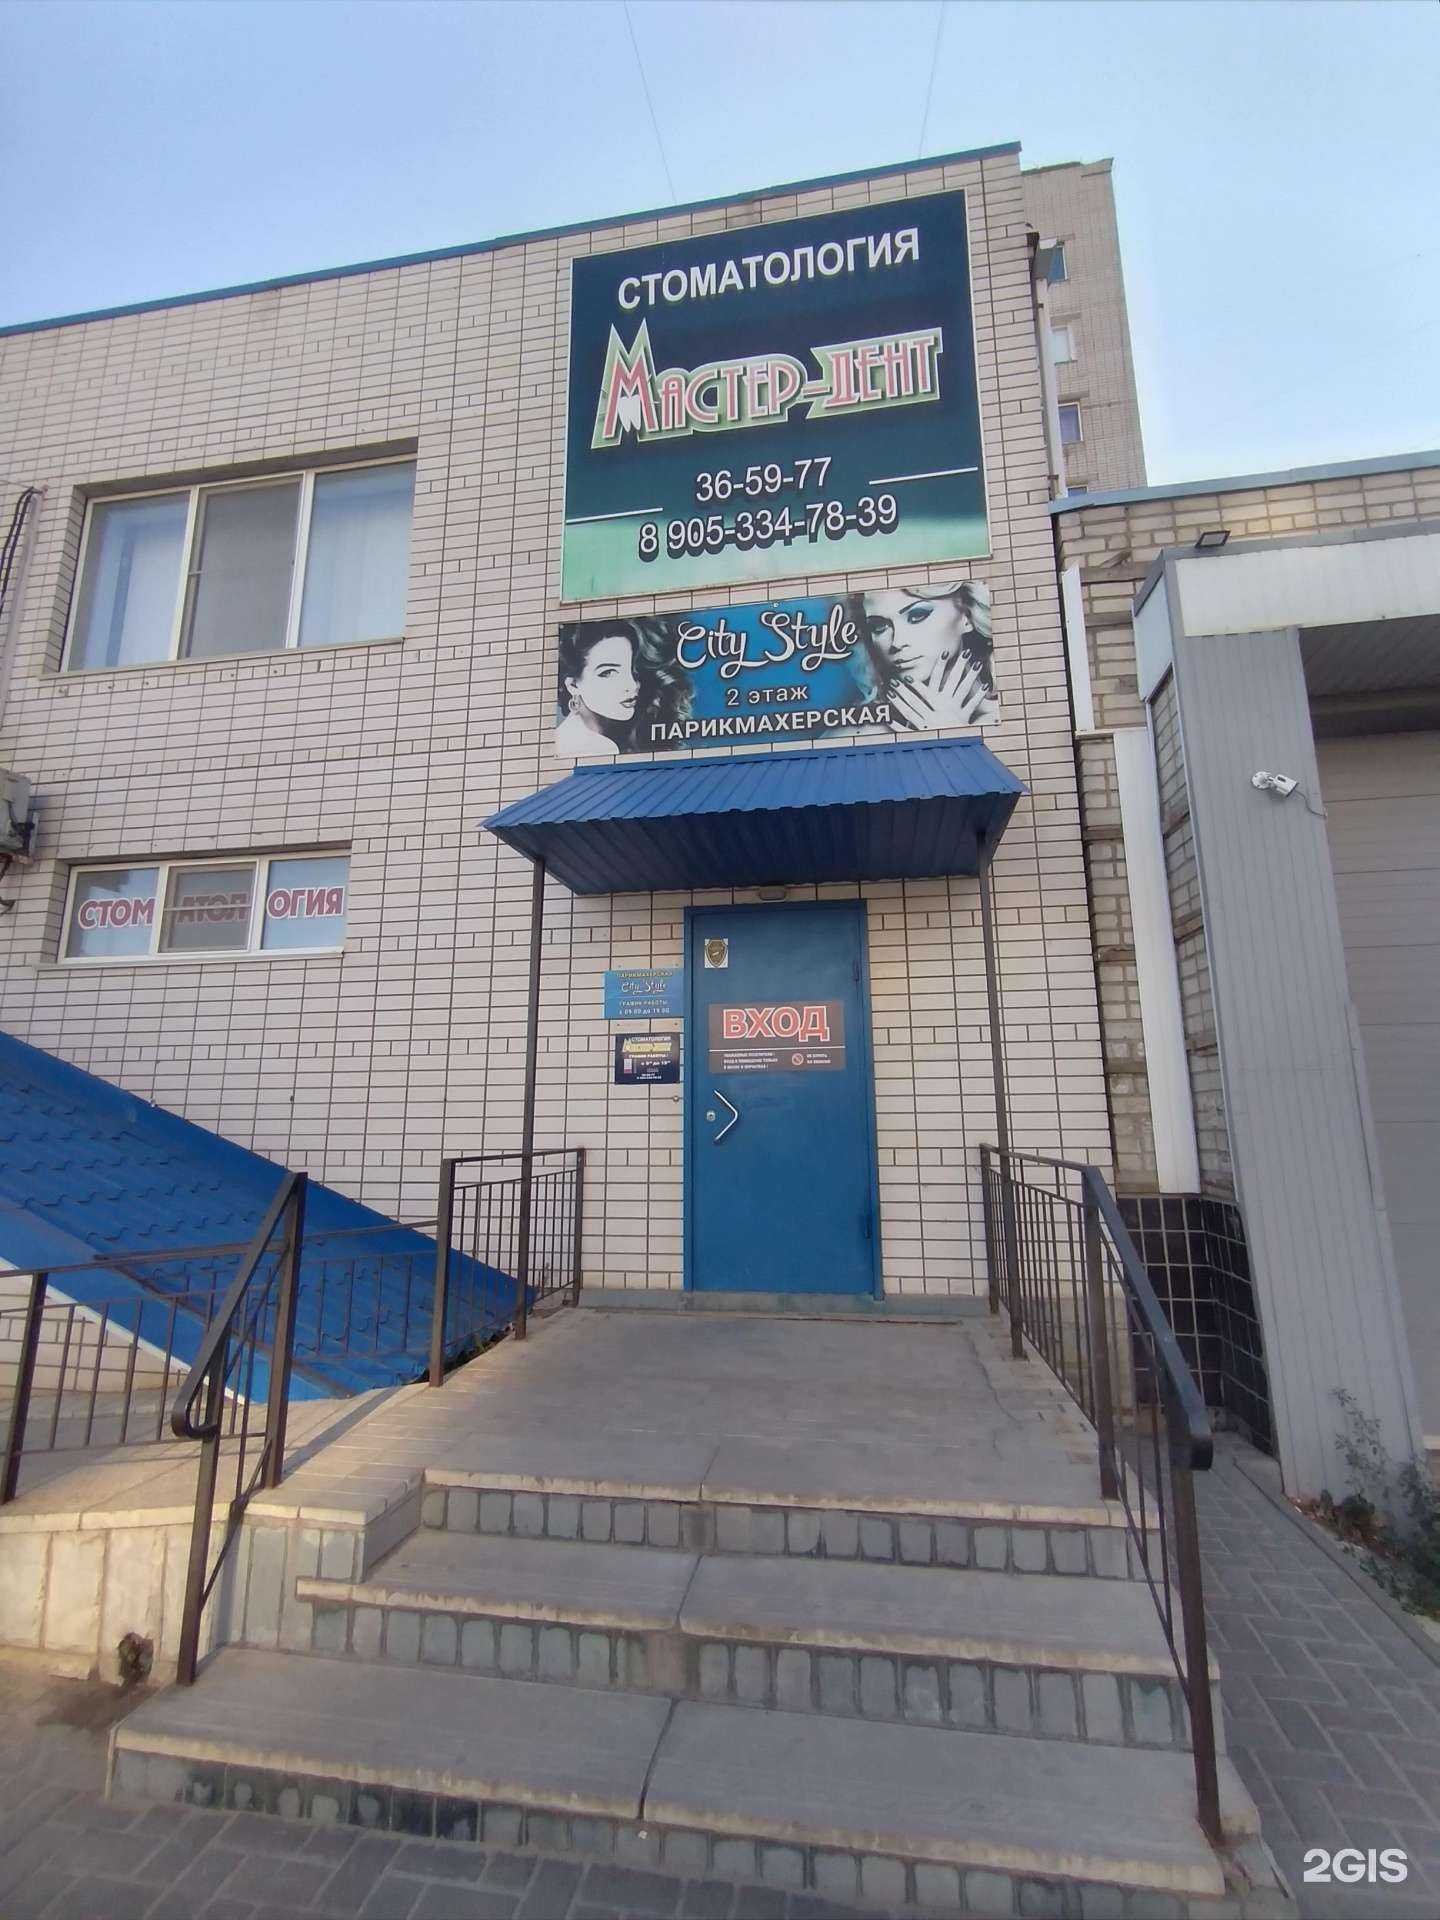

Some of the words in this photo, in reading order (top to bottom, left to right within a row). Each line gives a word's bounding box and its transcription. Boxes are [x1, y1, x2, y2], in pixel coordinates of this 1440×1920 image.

[617, 227, 920, 310] СТОМАТОЛОГИЯ
[695, 456, 832, 502] 36-59-77
[639, 523, 658, 555] 8
[667, 494, 897, 551] 905-334-78-39
[676, 620, 768, 679] City
[760, 604, 859, 672] Style
[726, 687, 740, 707] 2
[748, 685, 809, 705] этаж
[651, 703, 892, 741] ПАРИКМАХЕРСКАЯ
[723, 1005, 830, 1042] ВХОД
